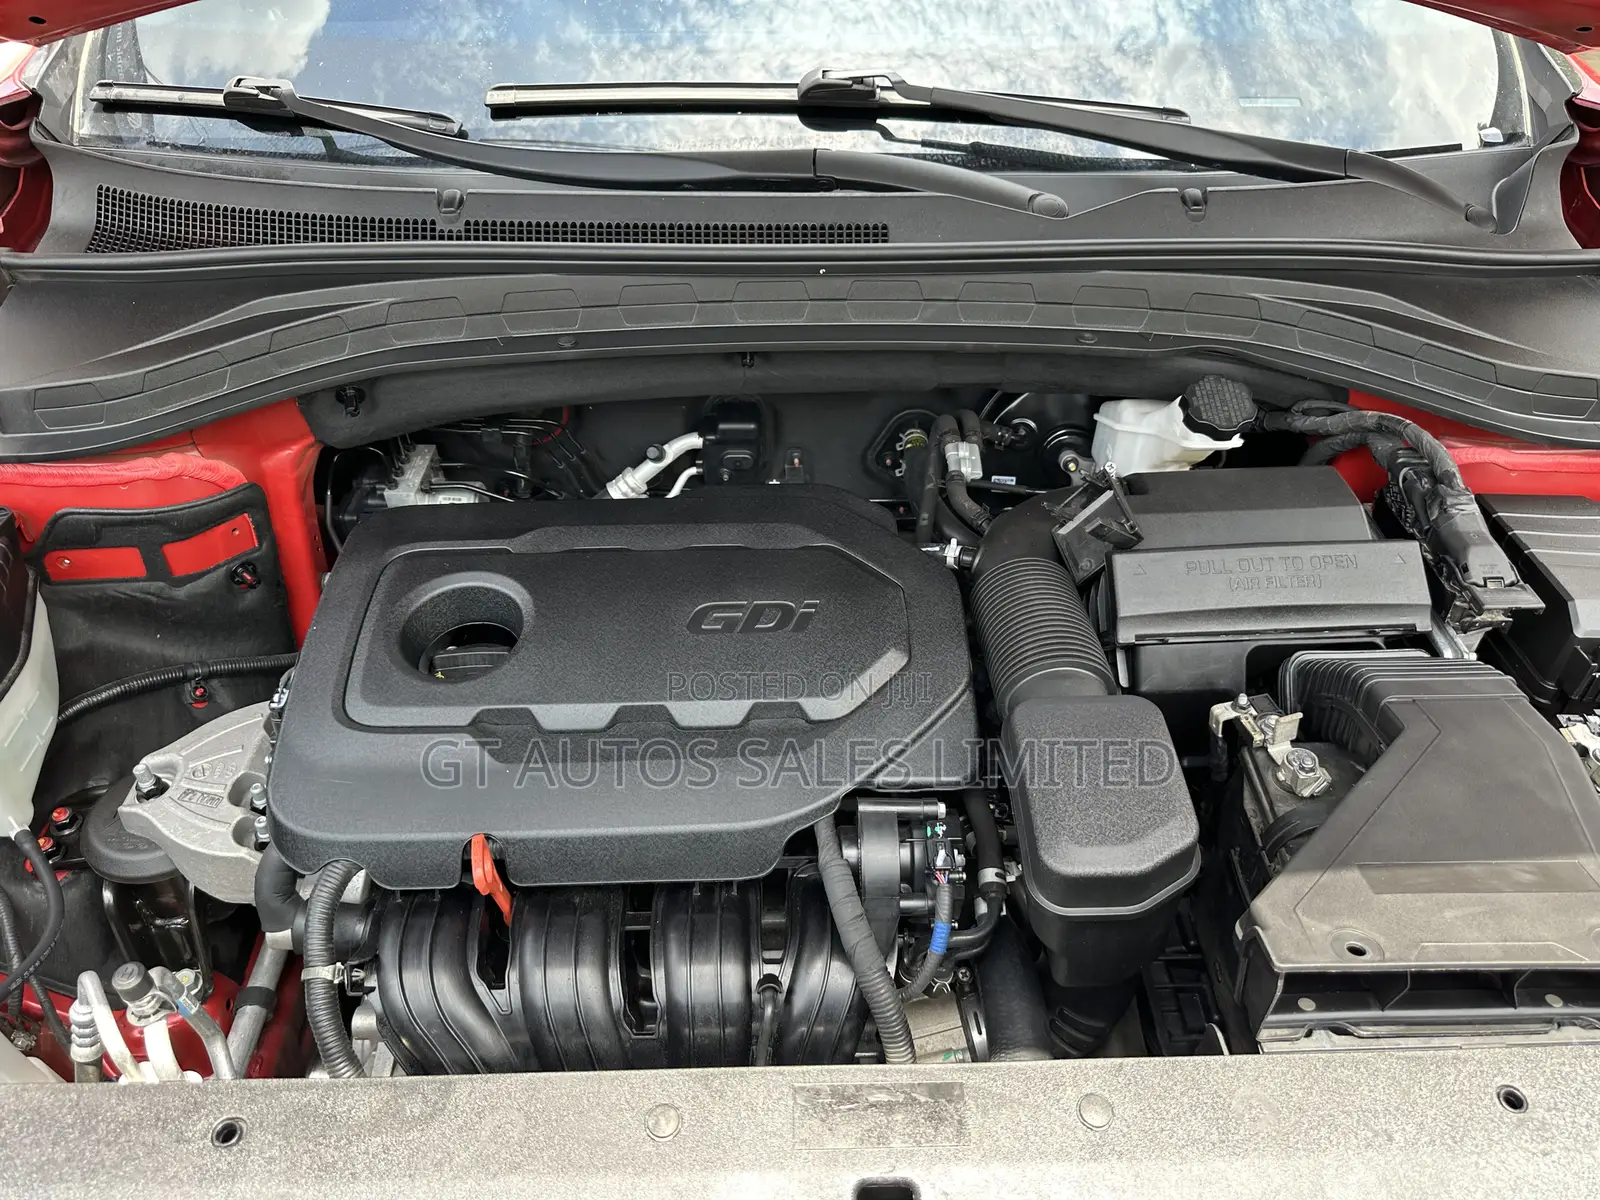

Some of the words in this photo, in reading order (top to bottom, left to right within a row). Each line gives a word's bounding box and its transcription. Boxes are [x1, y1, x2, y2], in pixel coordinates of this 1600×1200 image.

[1185, 559, 1232, 575] PULL
[1236, 556, 1274, 573] OUT
[1278, 556, 1304, 571] TO
[1309, 554, 1358, 571] OPEN
[686, 600, 820, 633] GDi
